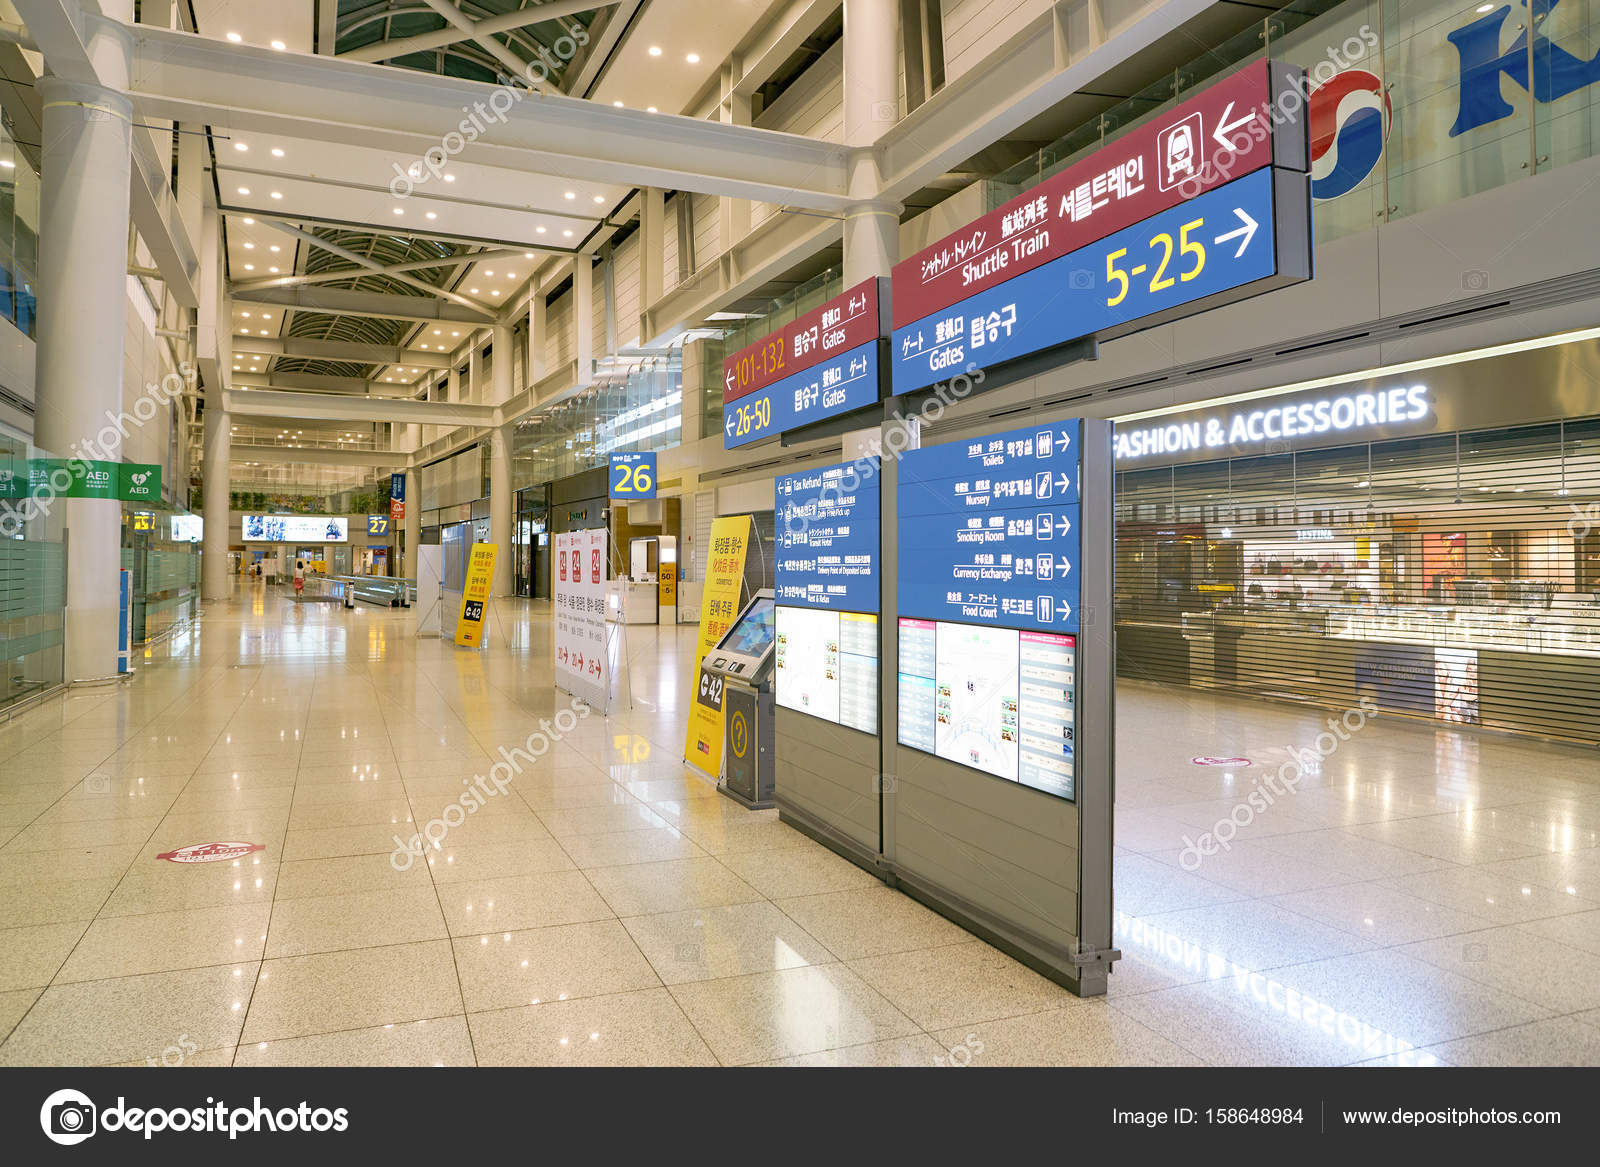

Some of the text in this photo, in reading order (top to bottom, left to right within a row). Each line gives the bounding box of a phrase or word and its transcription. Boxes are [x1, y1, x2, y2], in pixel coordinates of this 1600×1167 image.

[1058, 155, 1144, 222] 셔틀트레인
[1001, 195, 1048, 239] 航站列车
[962, 229, 1049, 286] Shuttle Train
[1106, 217, 1206, 307] 5-25
[848, 292, 867, 315] ゲート
[971, 303, 1017, 349] 탑승구
[794, 325, 818, 357] 탑승구
[822, 328, 846, 350] Gates
[902, 331, 923, 356] ゲート
[735, 338, 785, 389] 101-132
[849, 354, 867, 377] ゲート
[929, 344, 964, 371] Gates
[794, 383, 818, 412] 탑승구
[822, 388, 846, 408] Gates
[736, 397, 771, 436] 26-50
[1205, 419, 1225, 446] &
[1229, 385, 1428, 443] ACCESSORIES
[1007, 438, 1033, 457] 화장실
[983, 455, 1004, 466] Toilets
[86, 471, 109, 481] AED
[614, 464, 652, 492] 26
[793, 479, 802, 491] Tax
[802, 476, 822, 490] Refund
[993, 479, 1033, 498] 유아휴게실
[966, 495, 990, 507] Nursery
[818, 510, 826, 519] Duty
[369, 520, 388, 532] 27
[1007, 519, 1033, 536] 흡연실
[809, 538, 832, 547] Transit Hotel
[957, 531, 1004, 544] Smoking Room
[560, 553, 566, 572] 24
[573, 553, 580, 572] 24
[592, 553, 600, 571] 24
[860, 567, 871, 575] Goods
[1015, 558, 1033, 575] 환전
[953, 568, 1012, 581] Currency Exchange
[968, 593, 998, 604] フードコート
[1001, 598, 1034, 615] 푸드코트
[472, 607, 481, 619] 42
[962, 606, 998, 618] Food Court
[708, 678, 723, 704] 42
